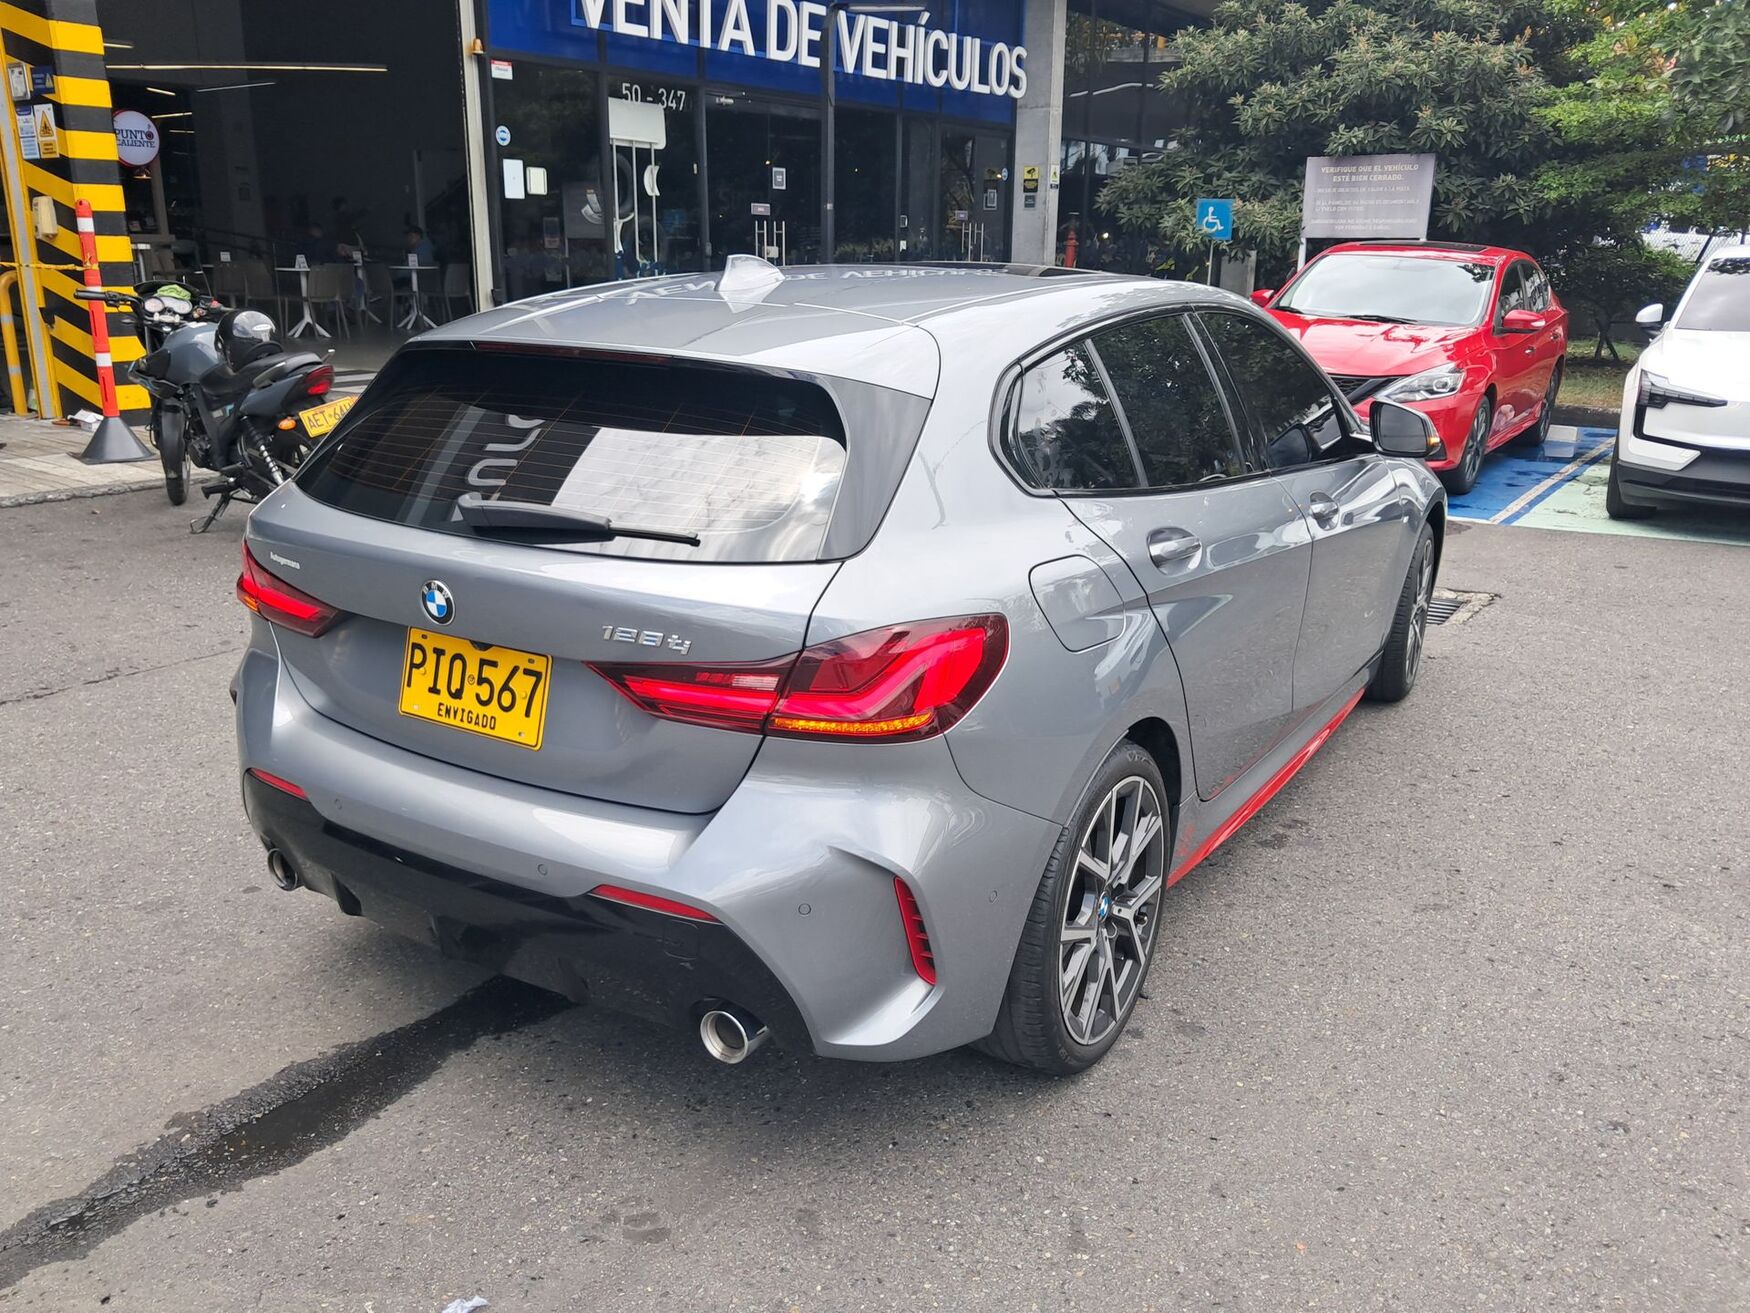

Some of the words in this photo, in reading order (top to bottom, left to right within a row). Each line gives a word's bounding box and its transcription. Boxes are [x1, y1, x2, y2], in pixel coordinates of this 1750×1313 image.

[766, 0, 827, 68] DE
[836, 10, 1028, 99] VEHÍCULOS
[622, 82, 642, 103] 50
[658, 88, 686, 111] 347
[1321, 165, 1357, 174] VERIFIQUE
[1358, 164, 1373, 172] QUE
[1374, 164, 1382, 172] EL
[1383, 162, 1419, 172] VEHÍCULO
[1333, 173, 1350, 182] ESTÉ
[306, 409, 331, 430] AET
[422, 581, 451, 599] BMW
[437, 702, 497, 731] ENVIGADO
